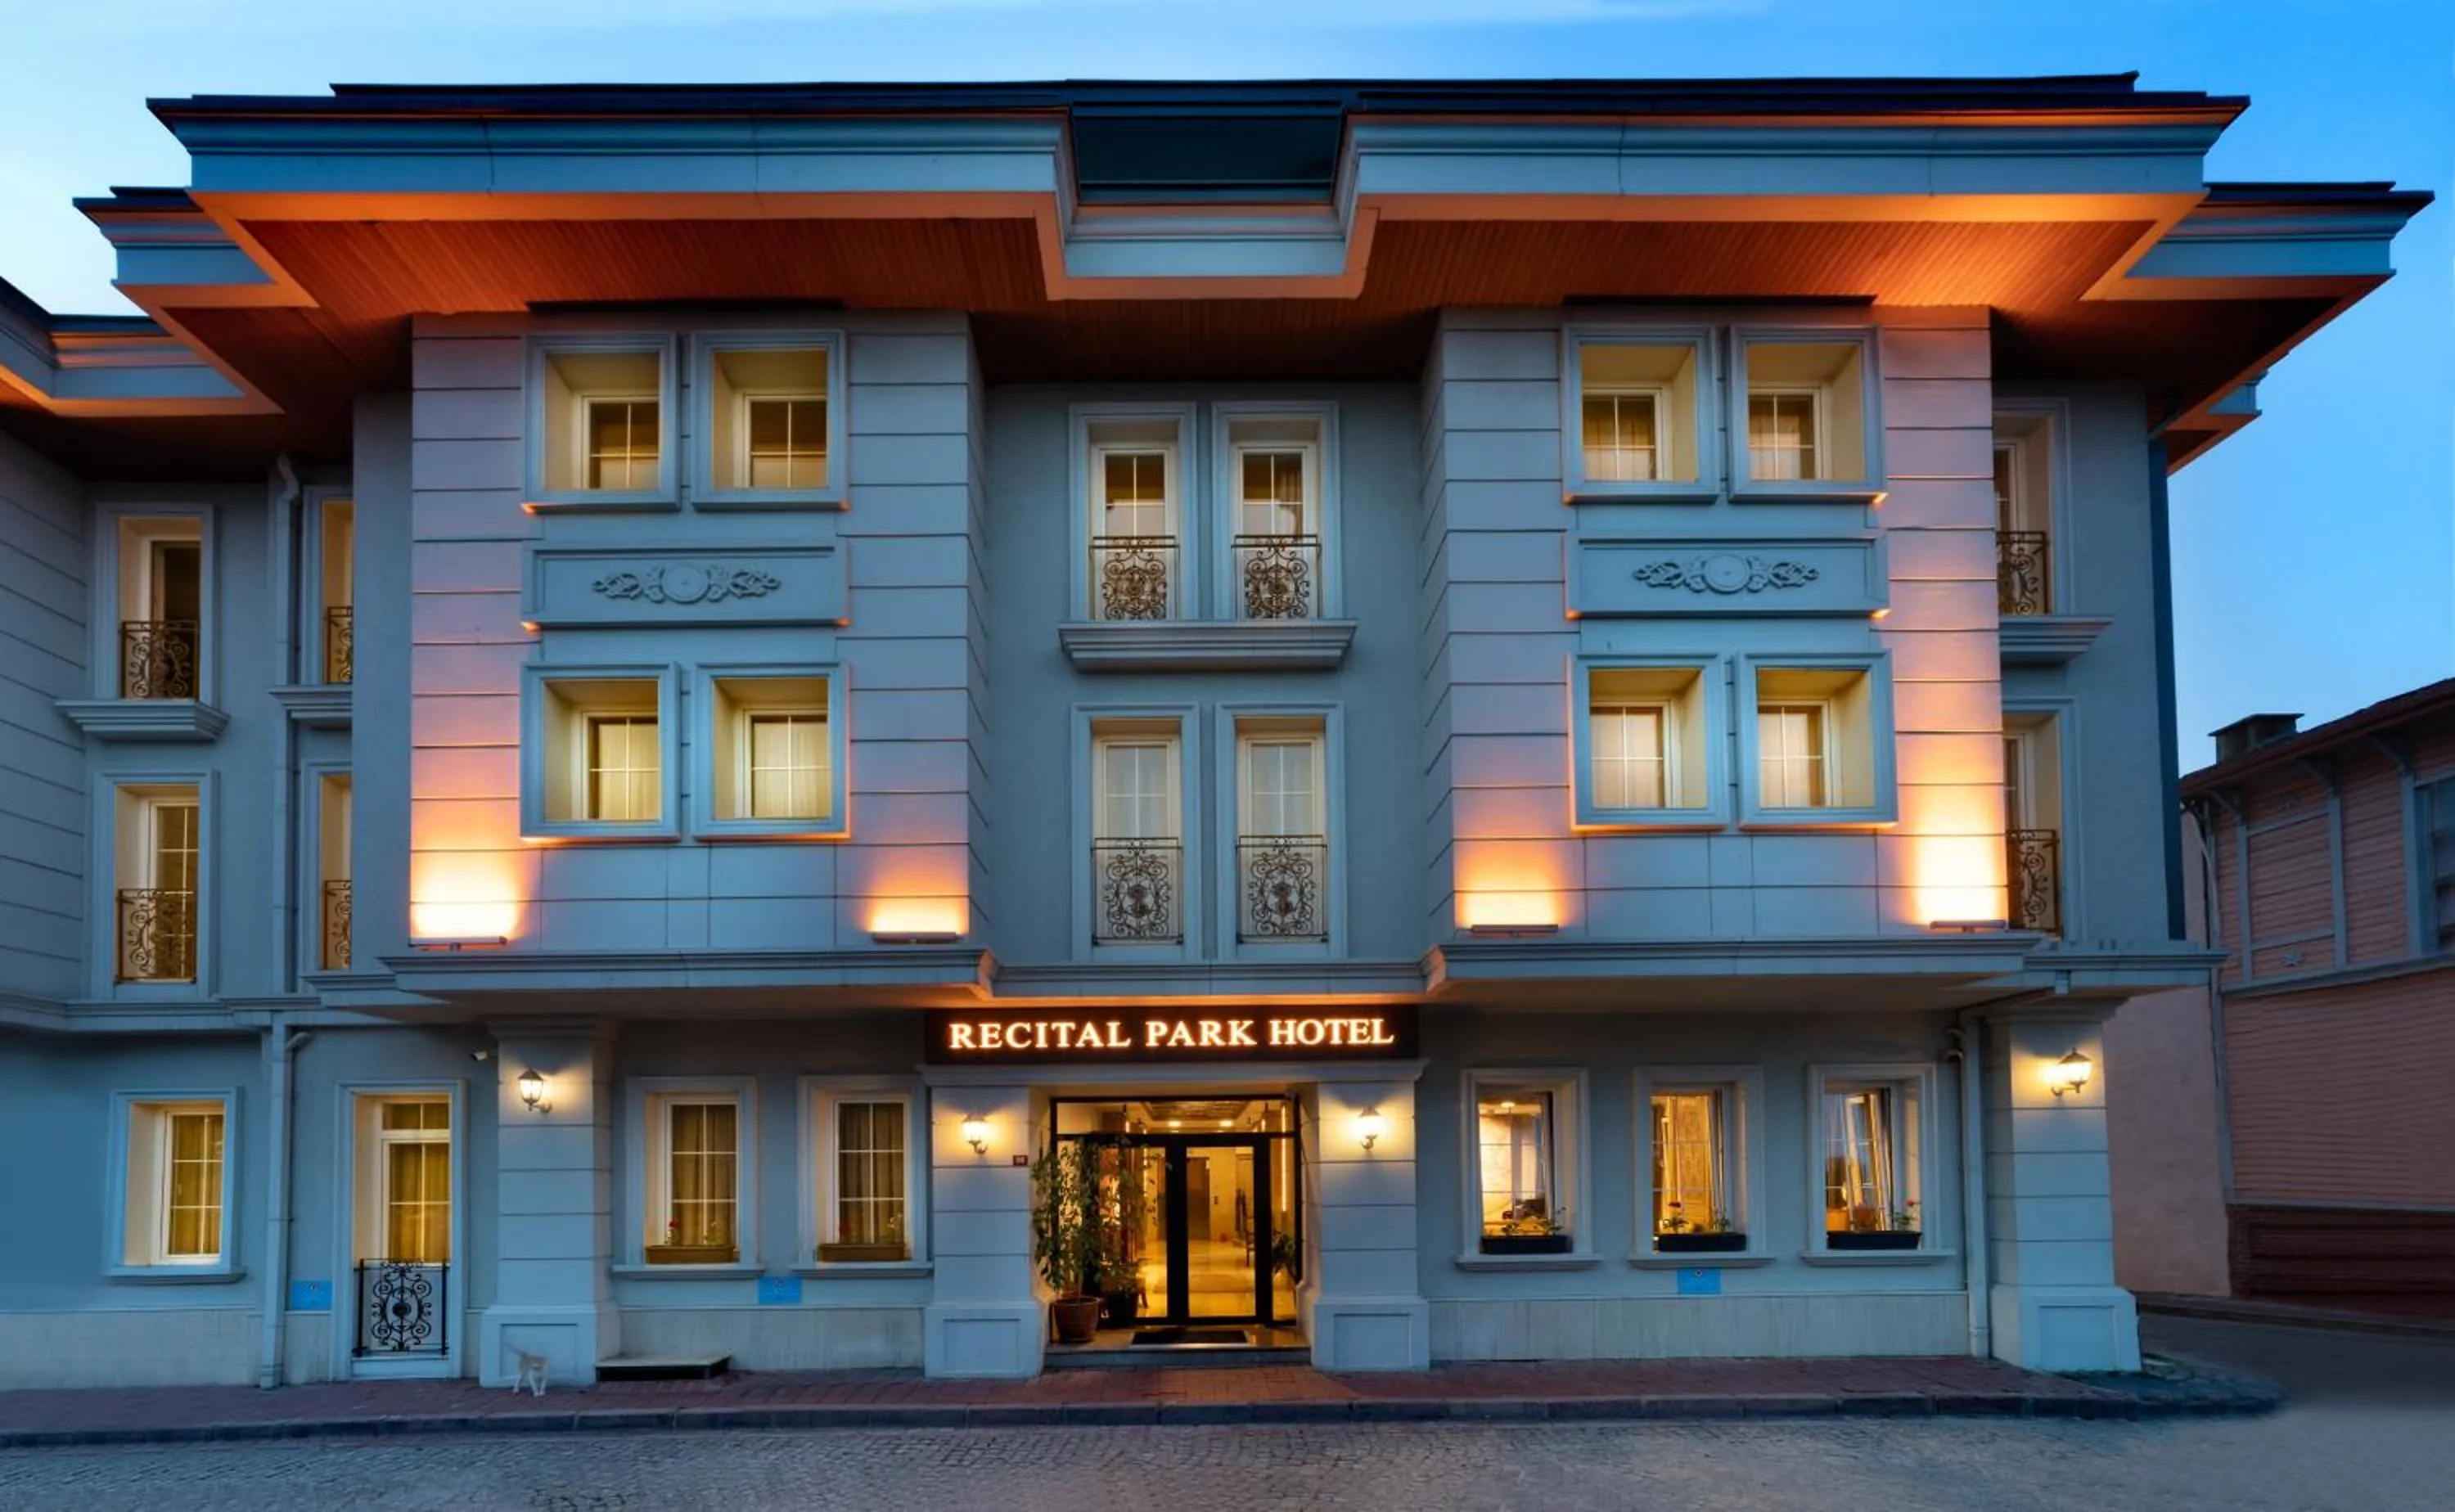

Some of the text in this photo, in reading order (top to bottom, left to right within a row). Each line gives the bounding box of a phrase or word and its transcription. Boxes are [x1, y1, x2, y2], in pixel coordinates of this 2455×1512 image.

[949, 1019, 1394, 1049] RECITAL PARK HOTEL
